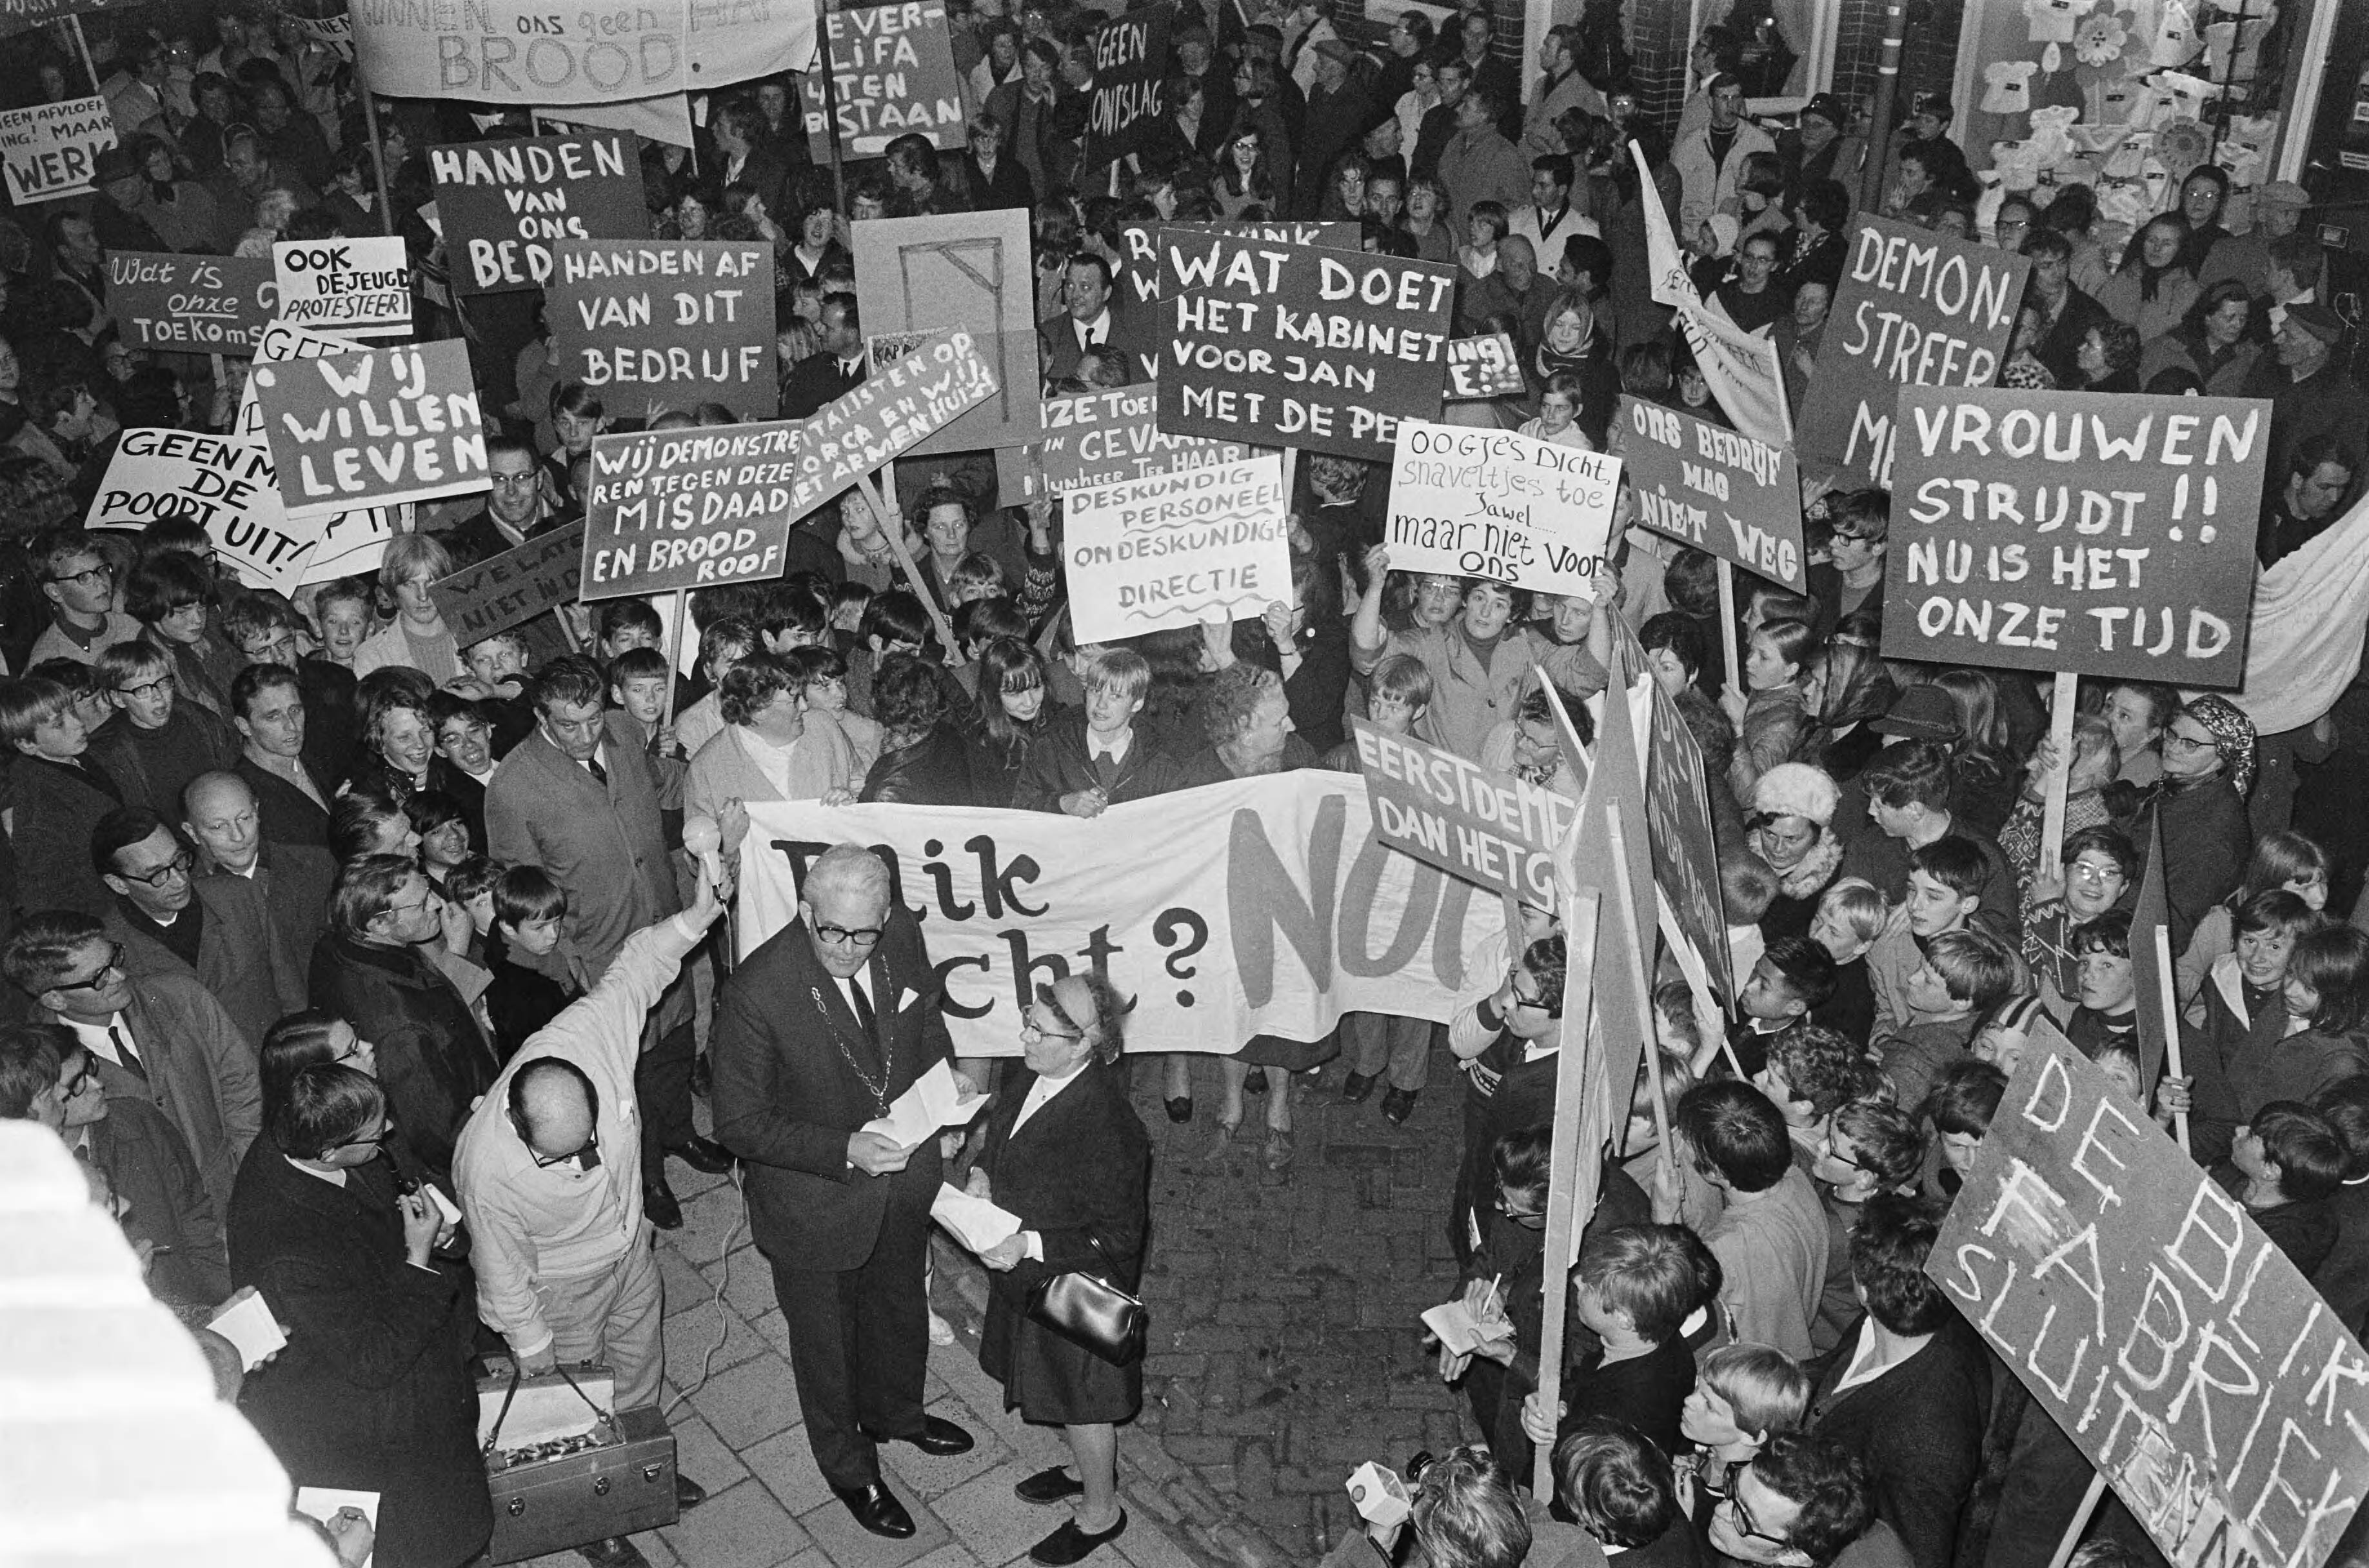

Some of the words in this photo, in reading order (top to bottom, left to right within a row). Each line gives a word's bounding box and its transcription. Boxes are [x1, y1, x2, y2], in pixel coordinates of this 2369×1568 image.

[438, 33, 679, 93] BROOD
[1097, 22, 1147, 71] GEEN
[50, 115, 114, 140] MAAR
[1092, 79, 1162, 137] ONTSLAG
[431, 137, 626, 186] HANDEN
[504, 187, 567, 214] VAN
[518, 215, 589, 241] ONS
[110, 256, 176, 285] Wat
[284, 245, 352, 273] OOK
[564, 248, 704, 284] HANDEN
[714, 250, 760, 277] AF
[1169, 240, 1289, 296] WAT
[1318, 257, 1452, 313] DOET
[1850, 226, 2013, 332] DEMON.
[282, 288, 411, 322] PROTESTEERT
[578, 292, 651, 331] VAN
[673, 288, 744, 325] DIT
[1176, 293, 1259, 333] HET
[1274, 304, 1444, 362] KABINET
[580, 345, 763, 386] BEDRIJF
[1172, 339, 1277, 375] VOOR
[1283, 355, 1376, 393] JAN
[281, 392, 482, 444] WILLEN
[878, 396, 917, 428] EN
[1181, 384, 1265, 424] MET
[1274, 397, 1334, 437] DE
[1345, 405, 1431, 443] PE
[1913, 403, 2259, 465] VROUWEN
[121, 431, 243, 471] GEEN
[299, 433, 488, 497] LEVEN
[1044, 437, 1065, 452] IN
[1171, 446, 1241, 473] HAAR
[177, 467, 259, 511] DE
[593, 478, 644, 505] REN
[650, 466, 732, 495] TEGEN
[737, 462, 794, 486] DEZE
[1071, 467, 1254, 515] DESKUNDIG
[1119, 482, 1284, 528] PERSONEEL
[1556, 479, 1605, 509] toe
[1681, 459, 1730, 502] MAG
[1908, 477, 2147, 537] STRIJDT
[224, 516, 317, 573] UIT!
[593, 543, 637, 582] EN
[646, 528, 757, 572] BROOD
[696, 544, 778, 582] ROOF
[1394, 513, 1477, 550] maar
[1483, 522, 1535, 566] niet
[1723, 511, 1798, 582] WEG
[1907, 536, 1973, 586] NU
[1987, 543, 2030, 582] IS
[2051, 541, 2150, 591] HET
[1118, 562, 1258, 608] DIRECTIE
[1916, 595, 2066, 650] ONZE
[2084, 605, 2232, 659] TIJD
[1378, 796, 1448, 857] DAN
[2022, 1053, 2141, 1206] DE
[1981, 1156, 2357, 1568] FABRIEK
